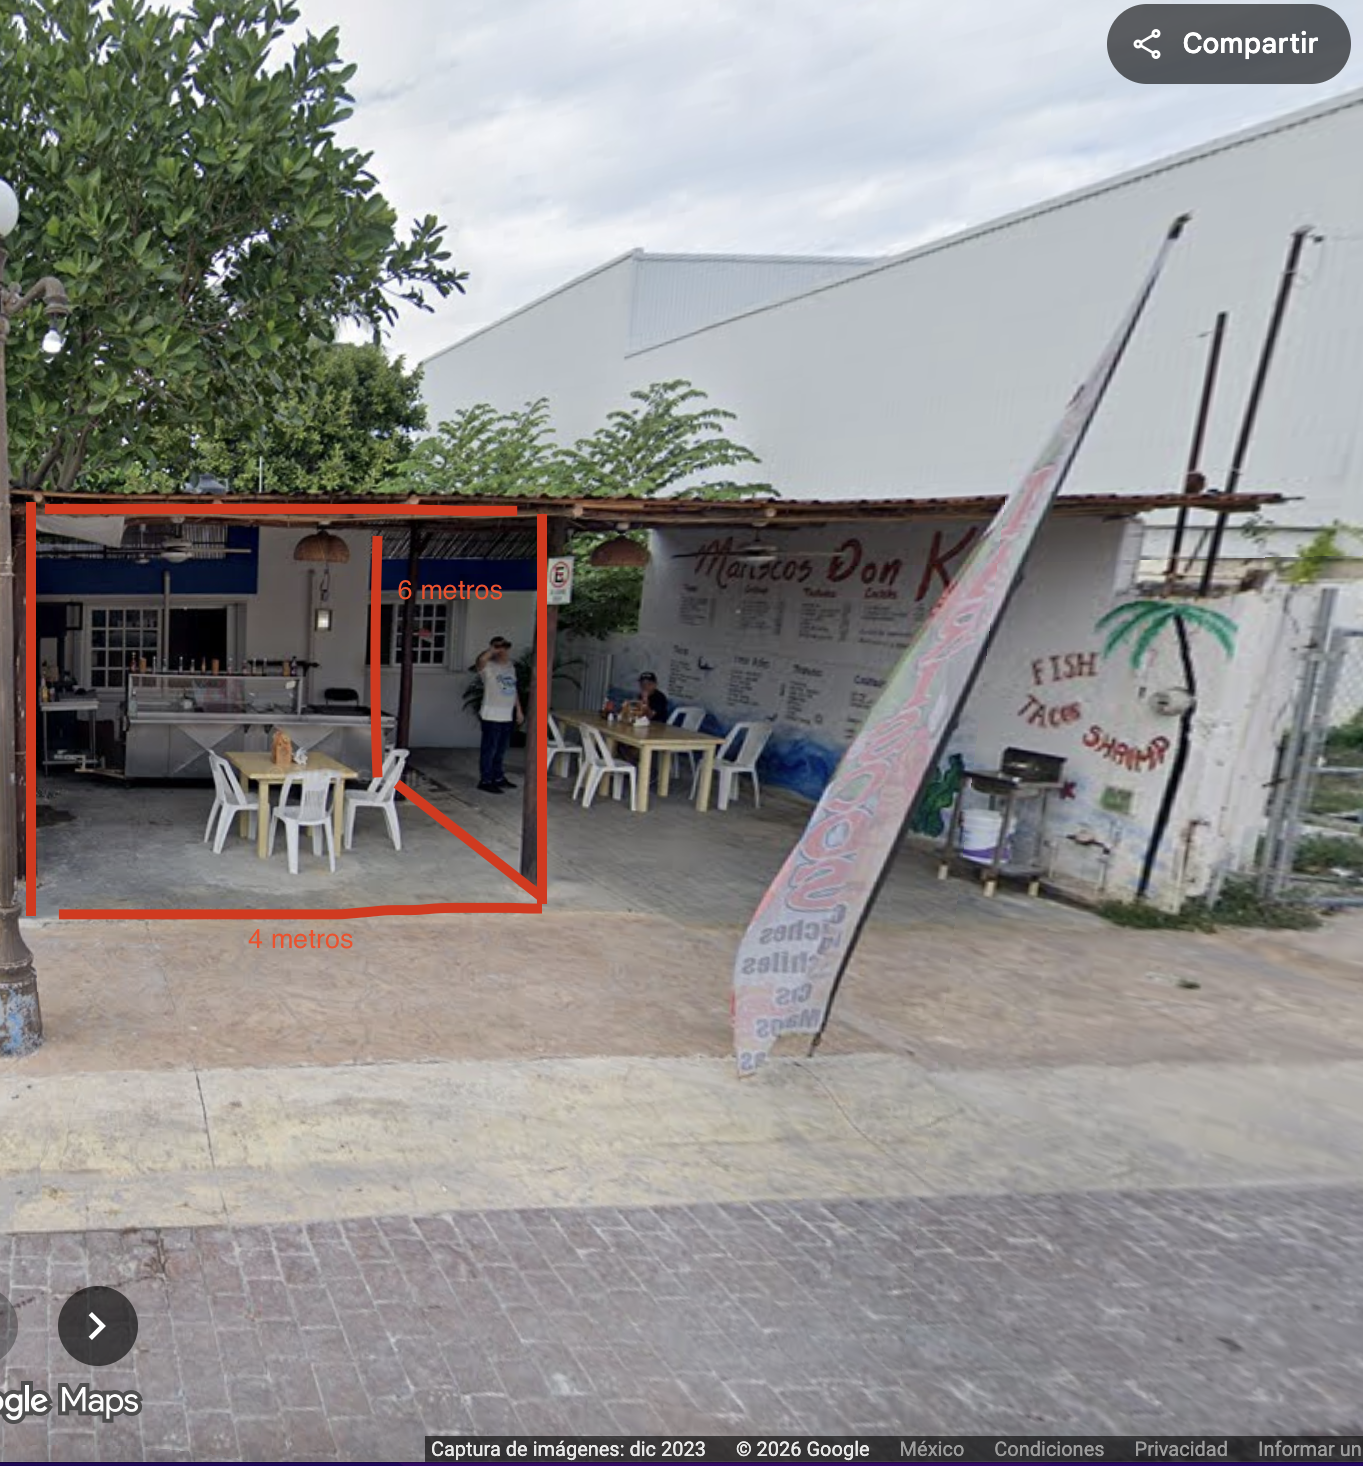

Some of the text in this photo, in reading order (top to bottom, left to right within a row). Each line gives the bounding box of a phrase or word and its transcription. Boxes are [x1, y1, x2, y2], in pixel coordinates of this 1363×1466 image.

[693, 536, 813, 589] Mariscos
[827, 538, 902, 584] Don
[1031, 651, 1098, 686] FISH
[1082, 724, 1170, 772] SHRIMP
